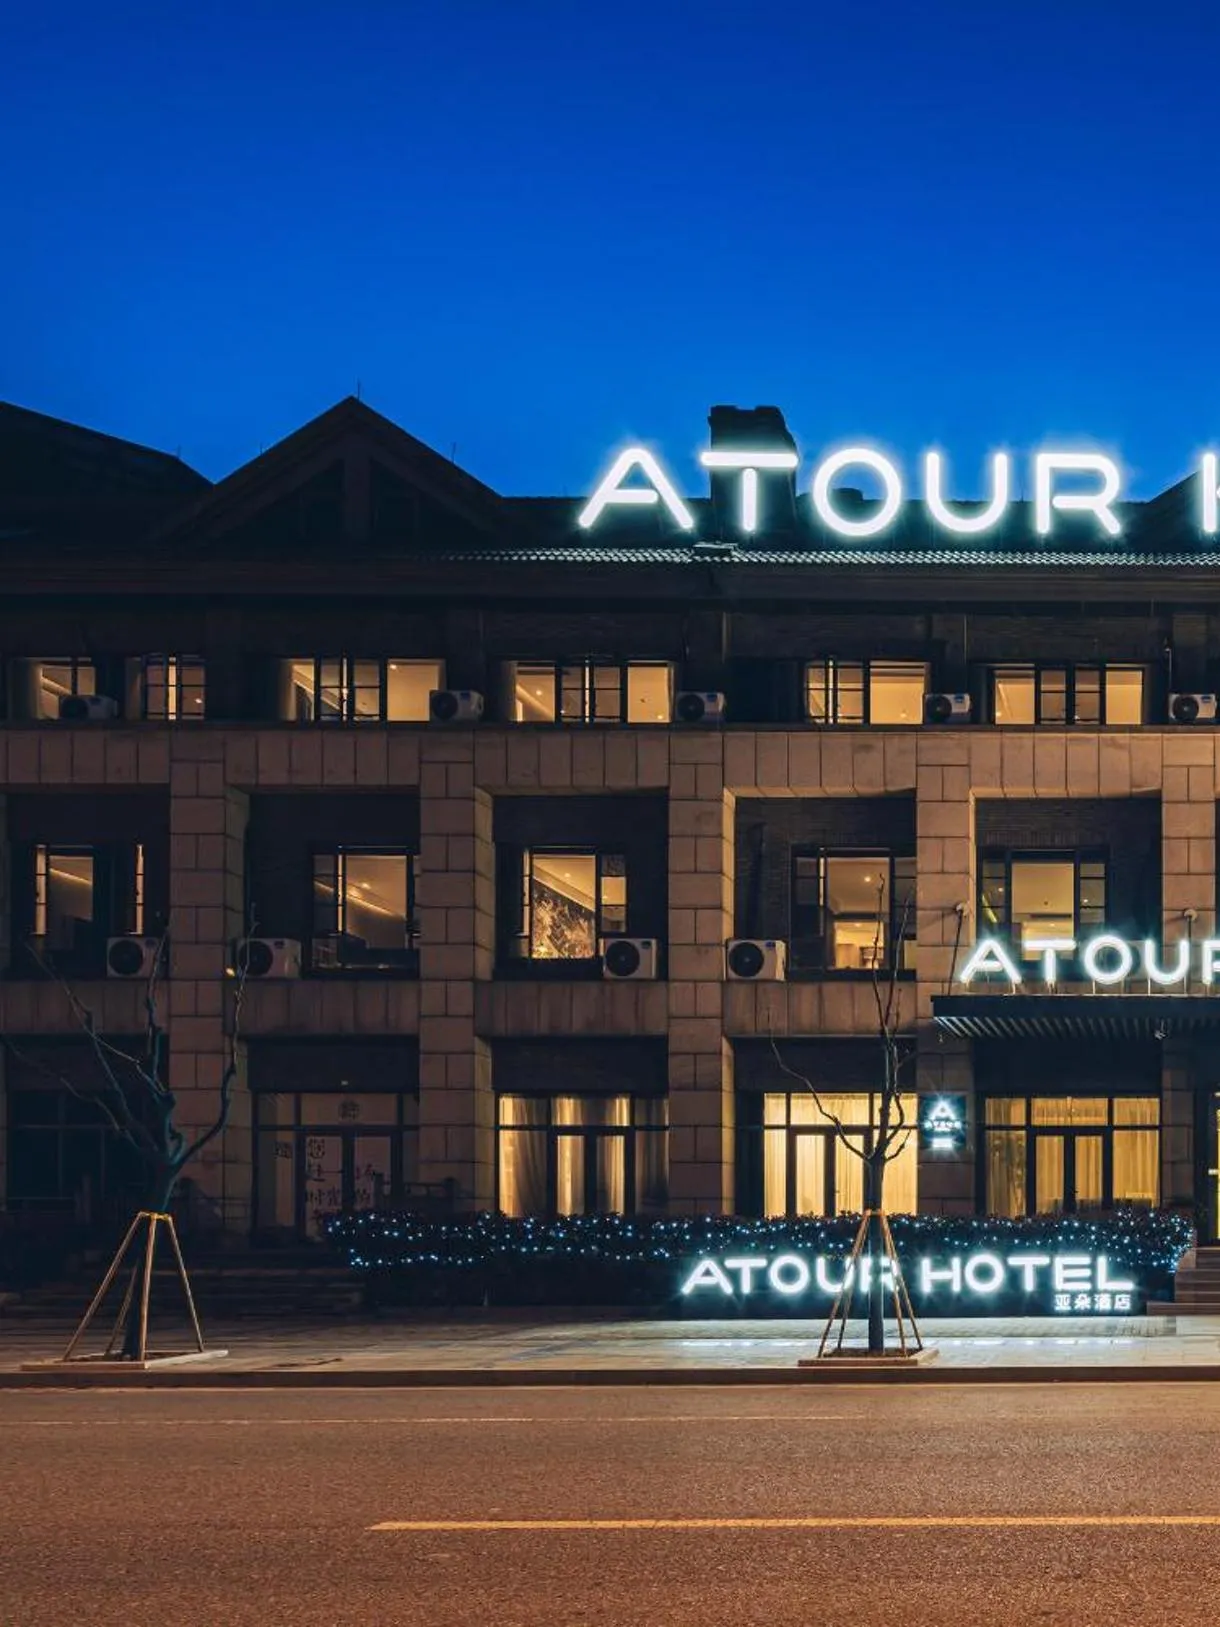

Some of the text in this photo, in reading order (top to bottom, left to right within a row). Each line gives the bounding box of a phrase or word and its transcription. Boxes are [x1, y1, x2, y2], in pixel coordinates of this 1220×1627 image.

[578, 447, 1121, 537] ATOUR
[682, 1254, 1135, 1295] ATOUR HOTEL
[1054, 1294, 1131, 1311] 亚朵酒店
